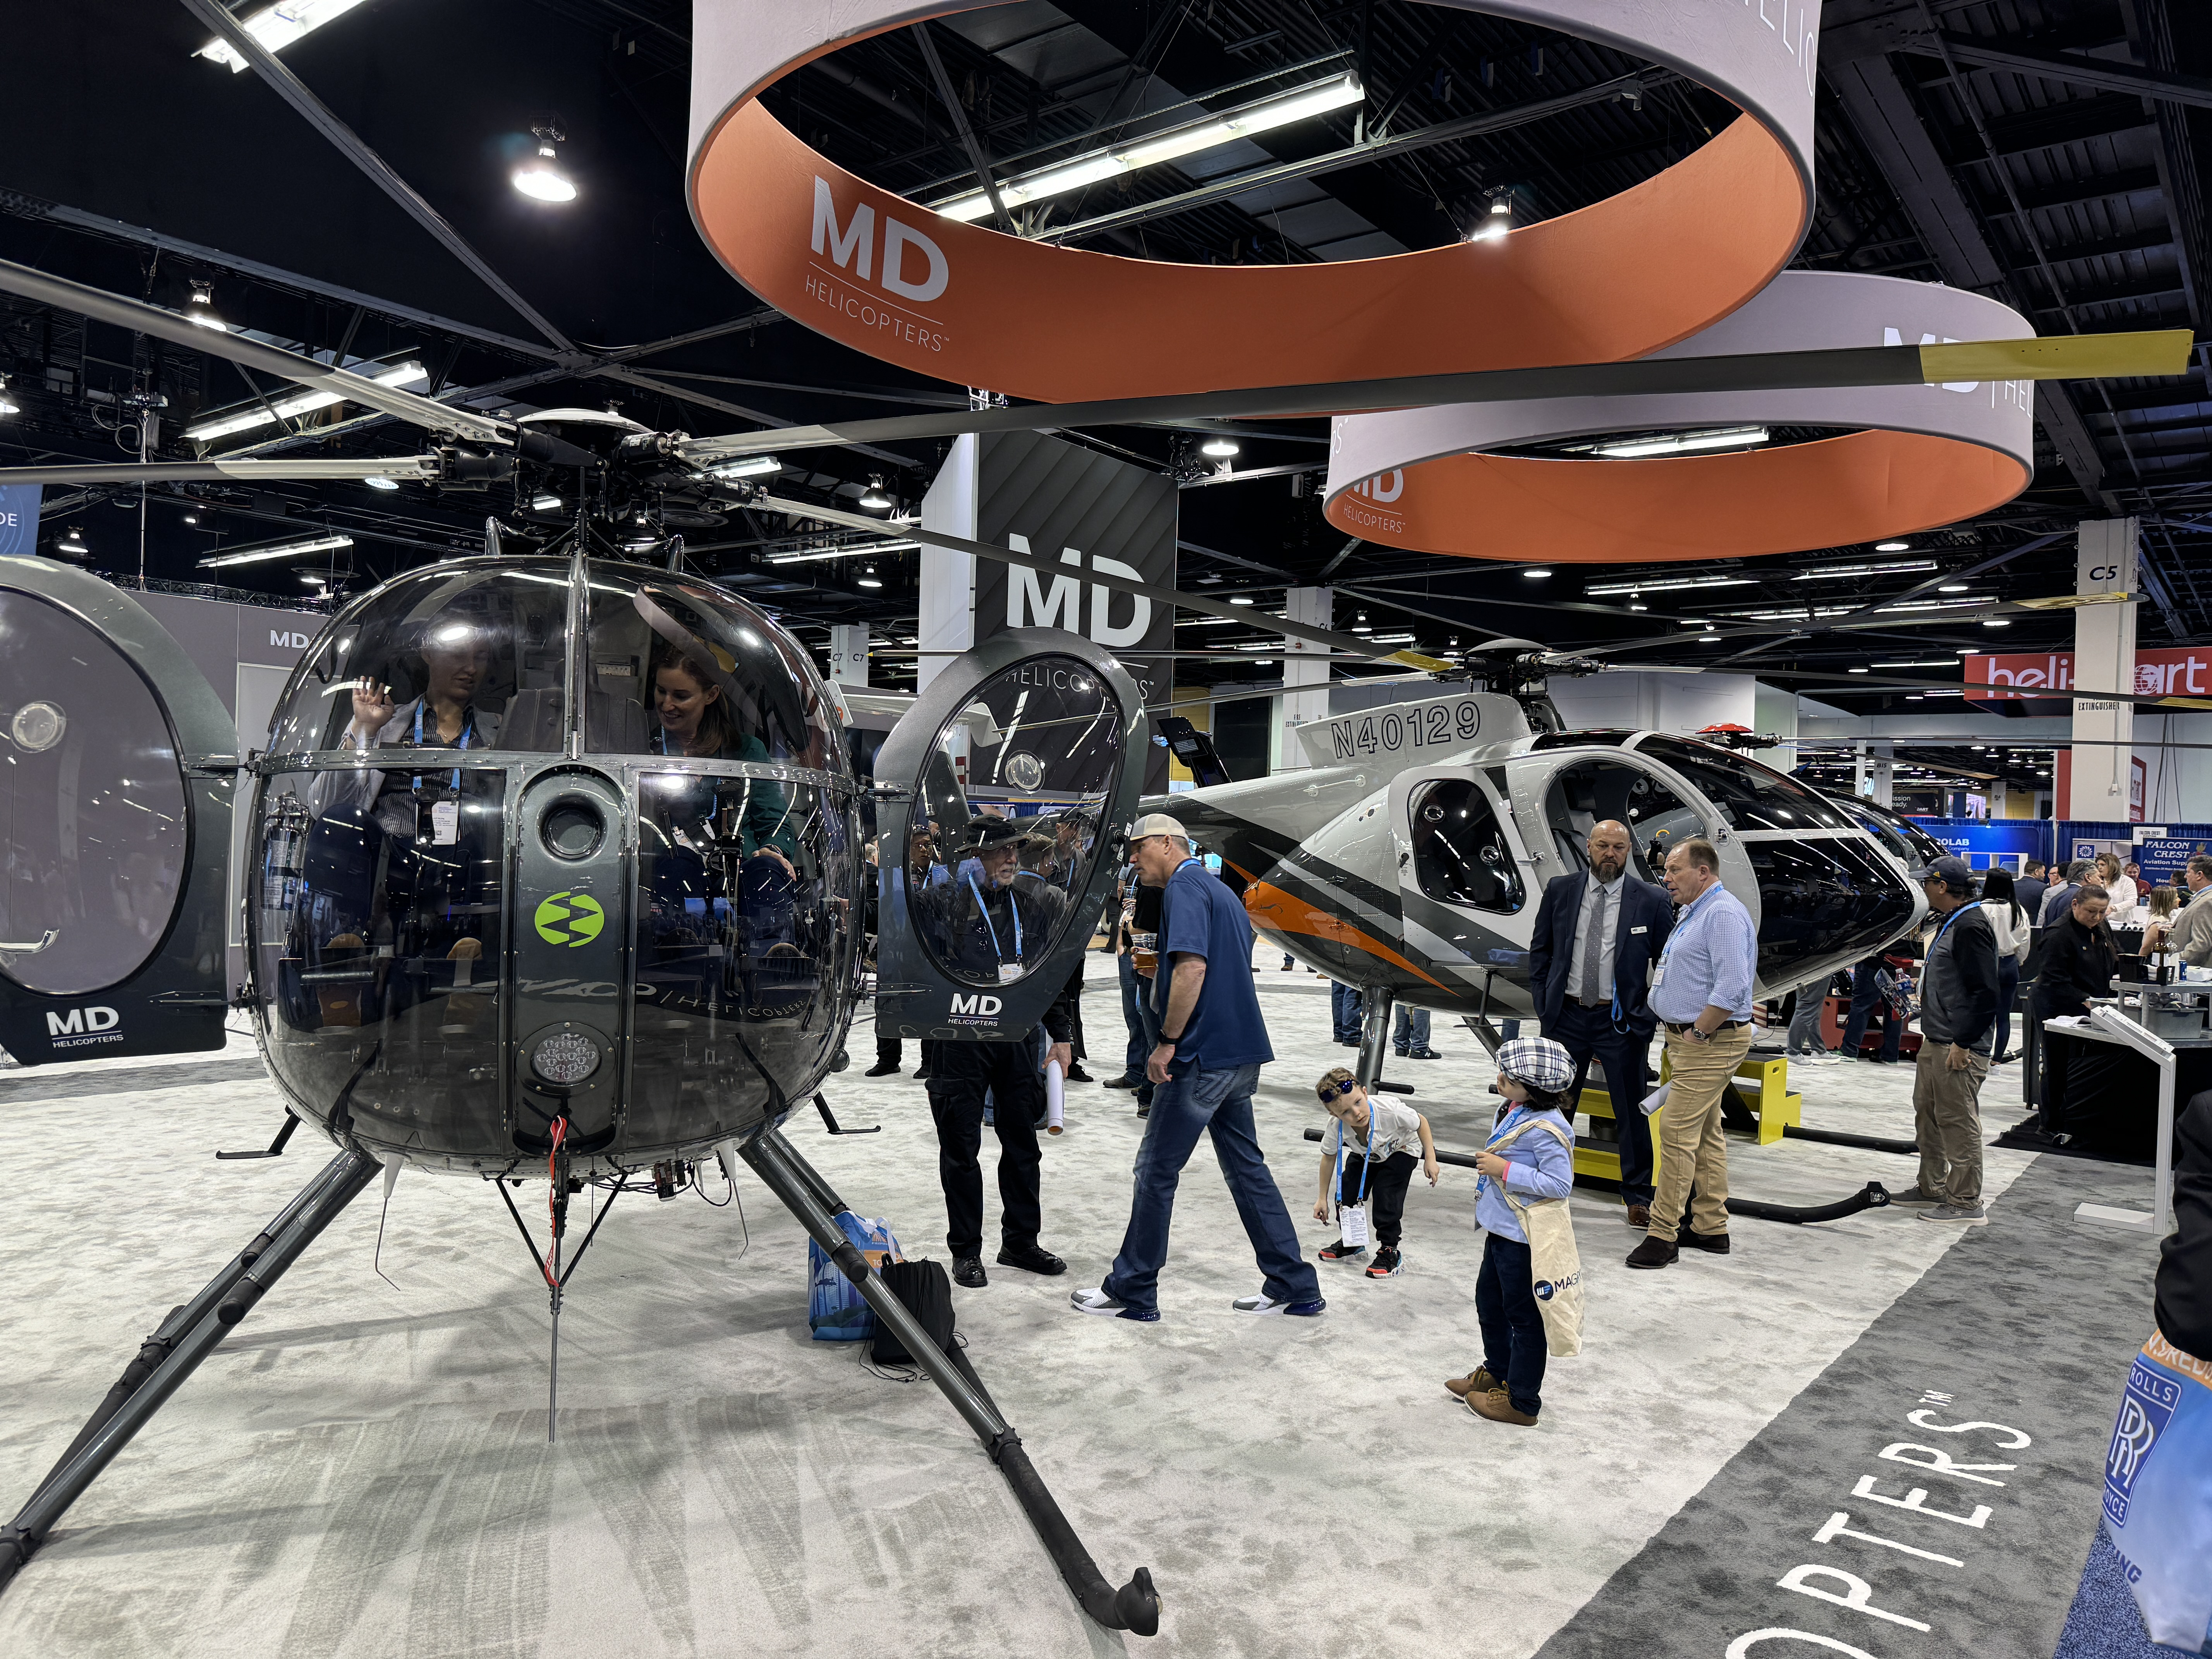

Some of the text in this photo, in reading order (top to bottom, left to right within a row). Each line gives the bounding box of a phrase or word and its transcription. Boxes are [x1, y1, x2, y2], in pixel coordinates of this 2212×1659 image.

[811, 175, 949, 302] MD
[2090, 565, 2118, 580] C5
[1007, 533, 1151, 647] MD
[270, 630, 309, 649] MD
[833, 653, 843, 661] C7
[853, 653, 864, 662] C7
[2078, 702, 2119, 711] EXTINGUISHER
[1331, 701, 1480, 759] N40129
[2145, 841, 2190, 849] FALCON
[2154, 850, 2190, 859] CREST
[950, 993, 1002, 1016] MD
[46, 1006, 119, 1036] MD
[948, 1018, 998, 1027] HELICOPTERS
[53, 1034, 124, 1048] HELICOPTERS
[2130, 1367, 2172, 1402] ROLLS
[2104, 1484, 2125, 1518] OYCE
